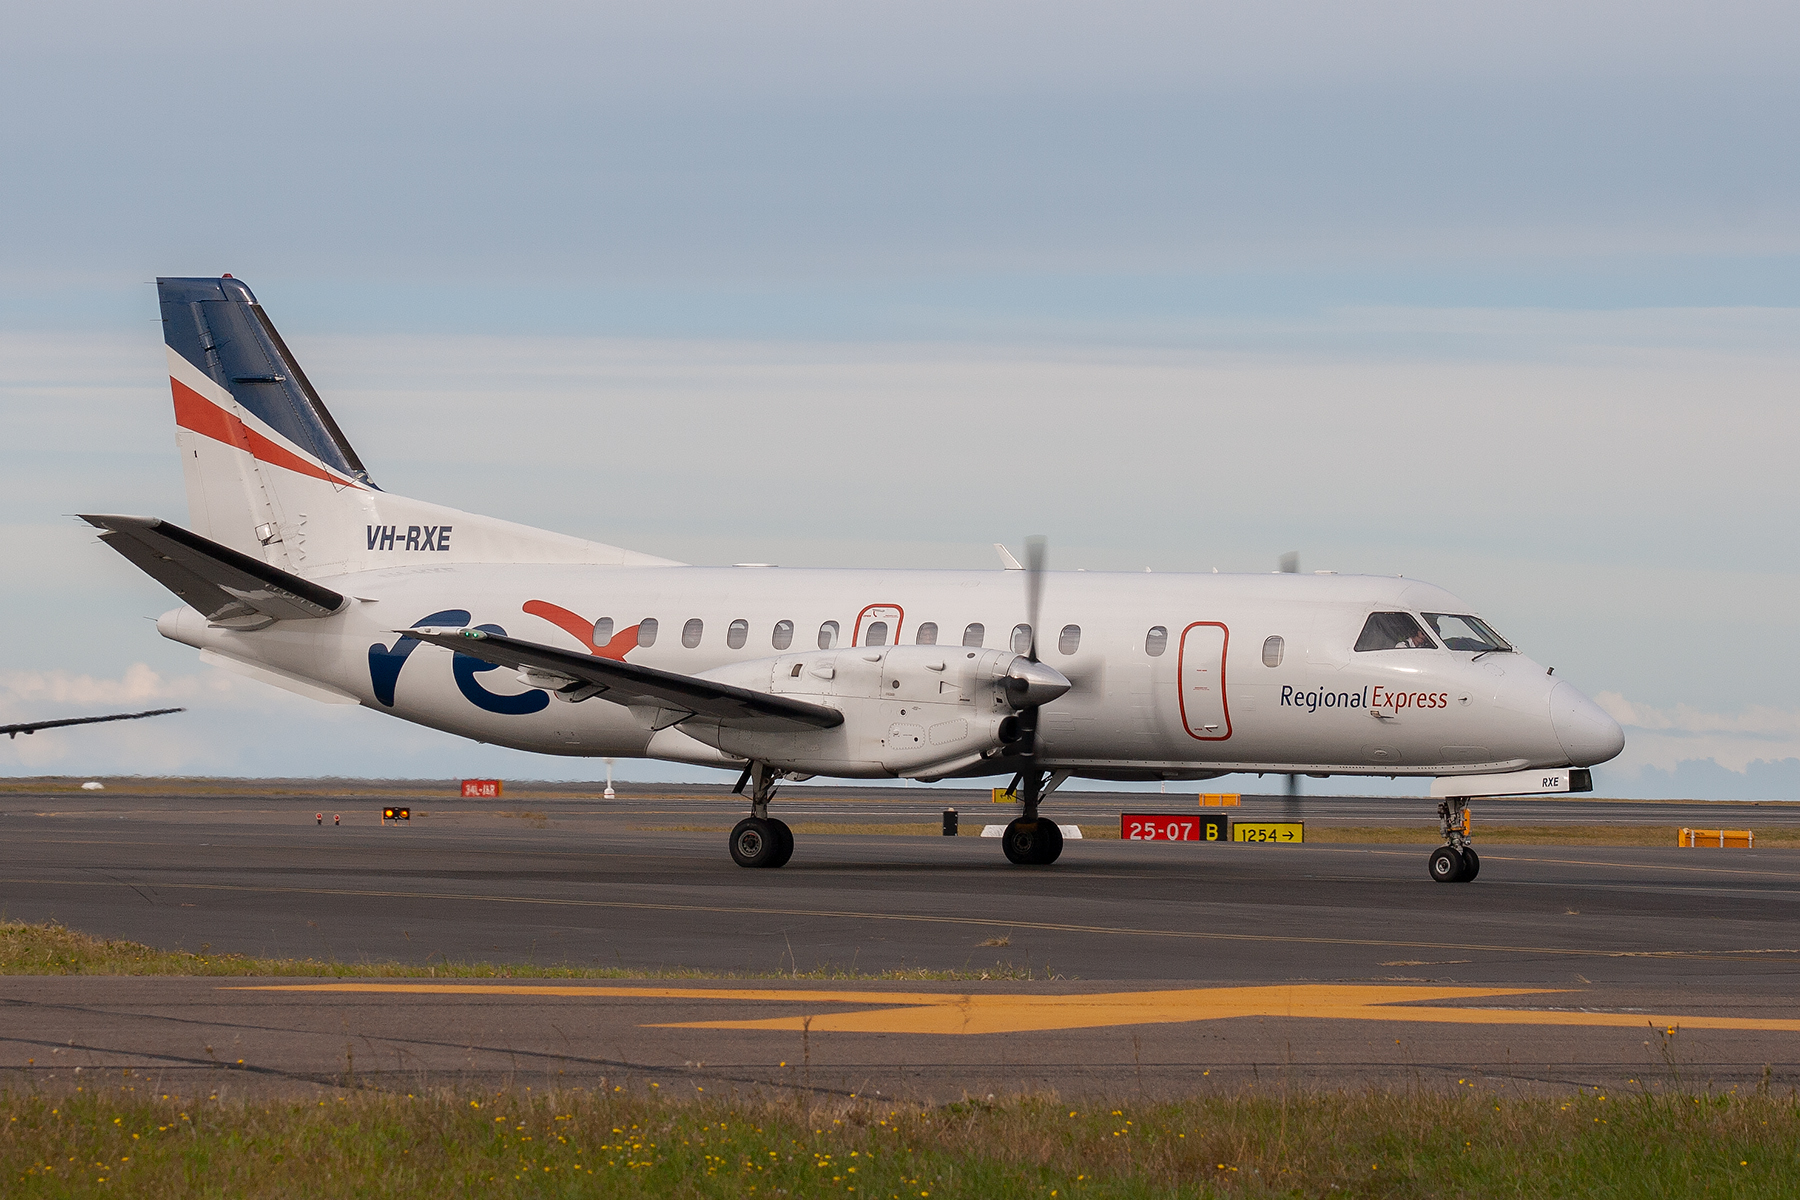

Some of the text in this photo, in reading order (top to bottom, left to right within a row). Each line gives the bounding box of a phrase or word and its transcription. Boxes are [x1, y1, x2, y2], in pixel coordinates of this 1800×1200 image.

[367, 525, 452, 551] VH-RXE
[1280, 685, 1448, 714] Regional Express
[1542, 777, 1559, 787] RXE
[1129, 822, 1219, 841] 25-07 B
[1242, 829, 1277, 842] 1254
